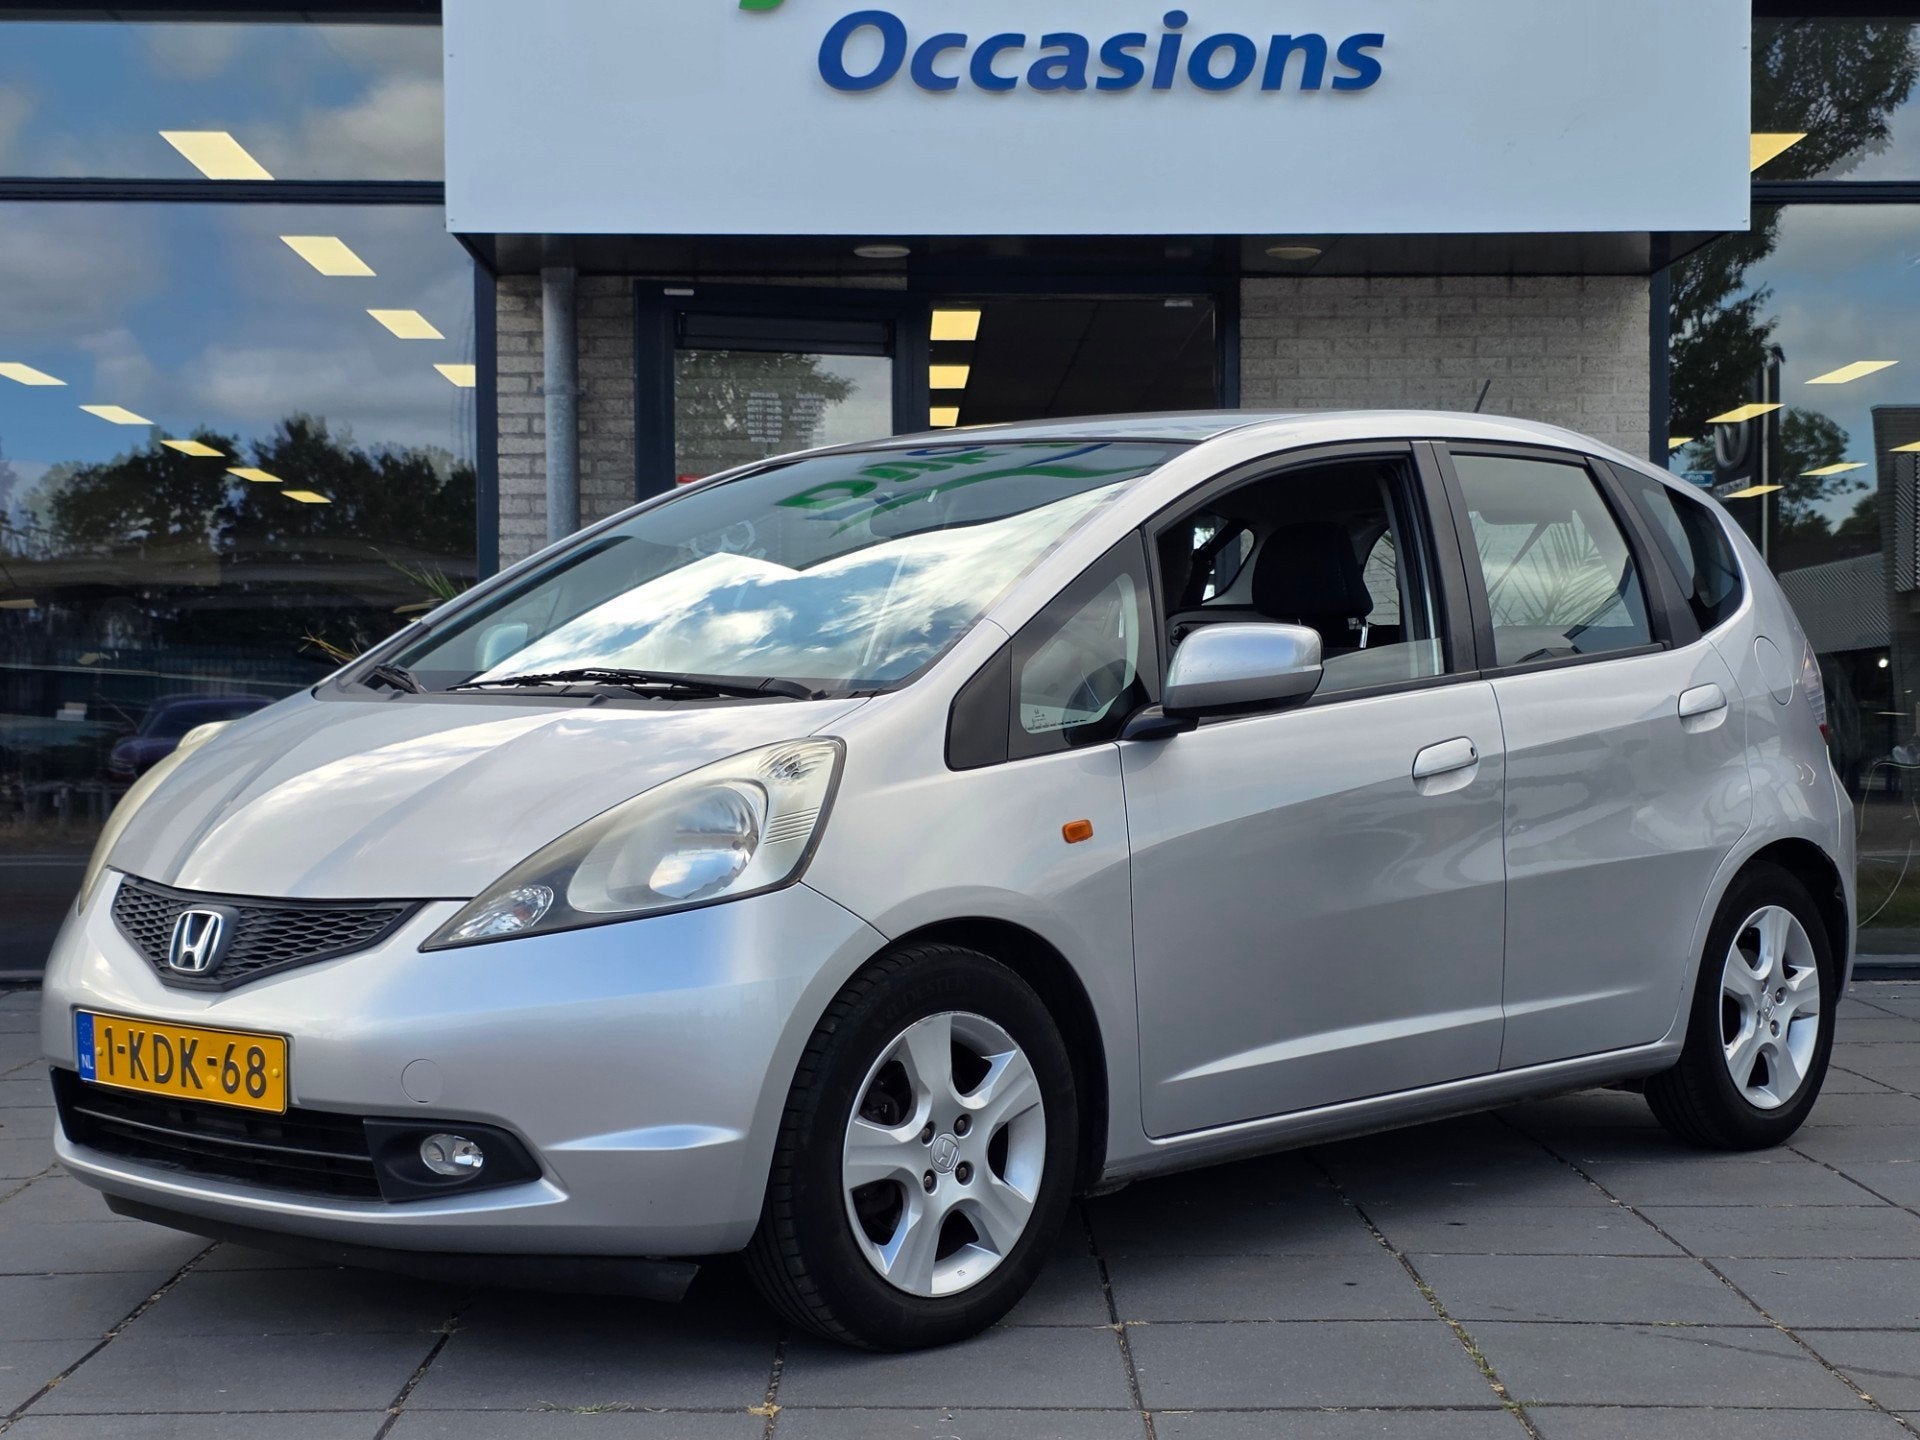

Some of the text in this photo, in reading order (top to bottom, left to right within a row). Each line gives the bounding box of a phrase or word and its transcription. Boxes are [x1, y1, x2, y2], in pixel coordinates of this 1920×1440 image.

[818, 9, 1385, 92] Occasions
[81, 1053, 94, 1070] NL
[104, 1025, 267, 1099] 1-KDK-68
